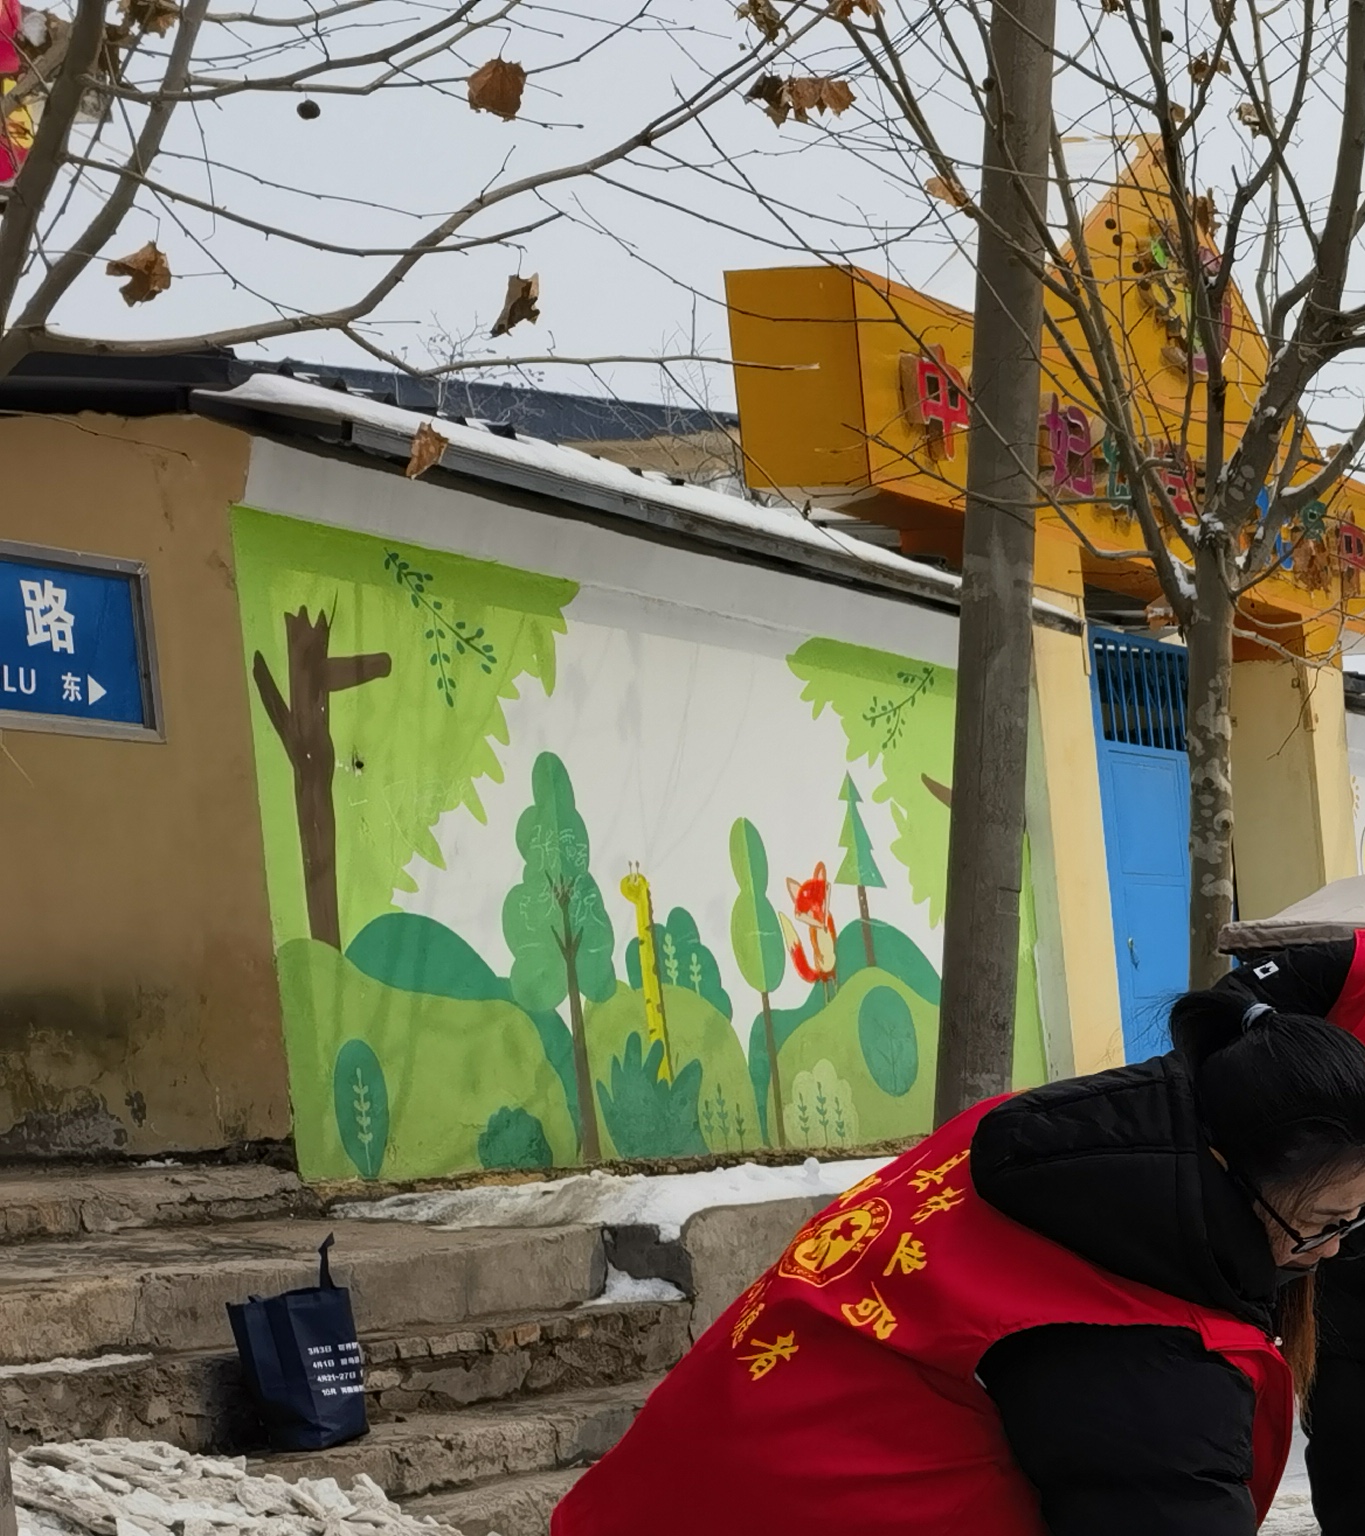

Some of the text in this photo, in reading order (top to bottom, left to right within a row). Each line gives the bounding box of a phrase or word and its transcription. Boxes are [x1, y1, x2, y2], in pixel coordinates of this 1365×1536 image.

[20, 579, 75, 654] 路
[3, 664, 36, 695] LU
[61, 672, 83, 702] 东
